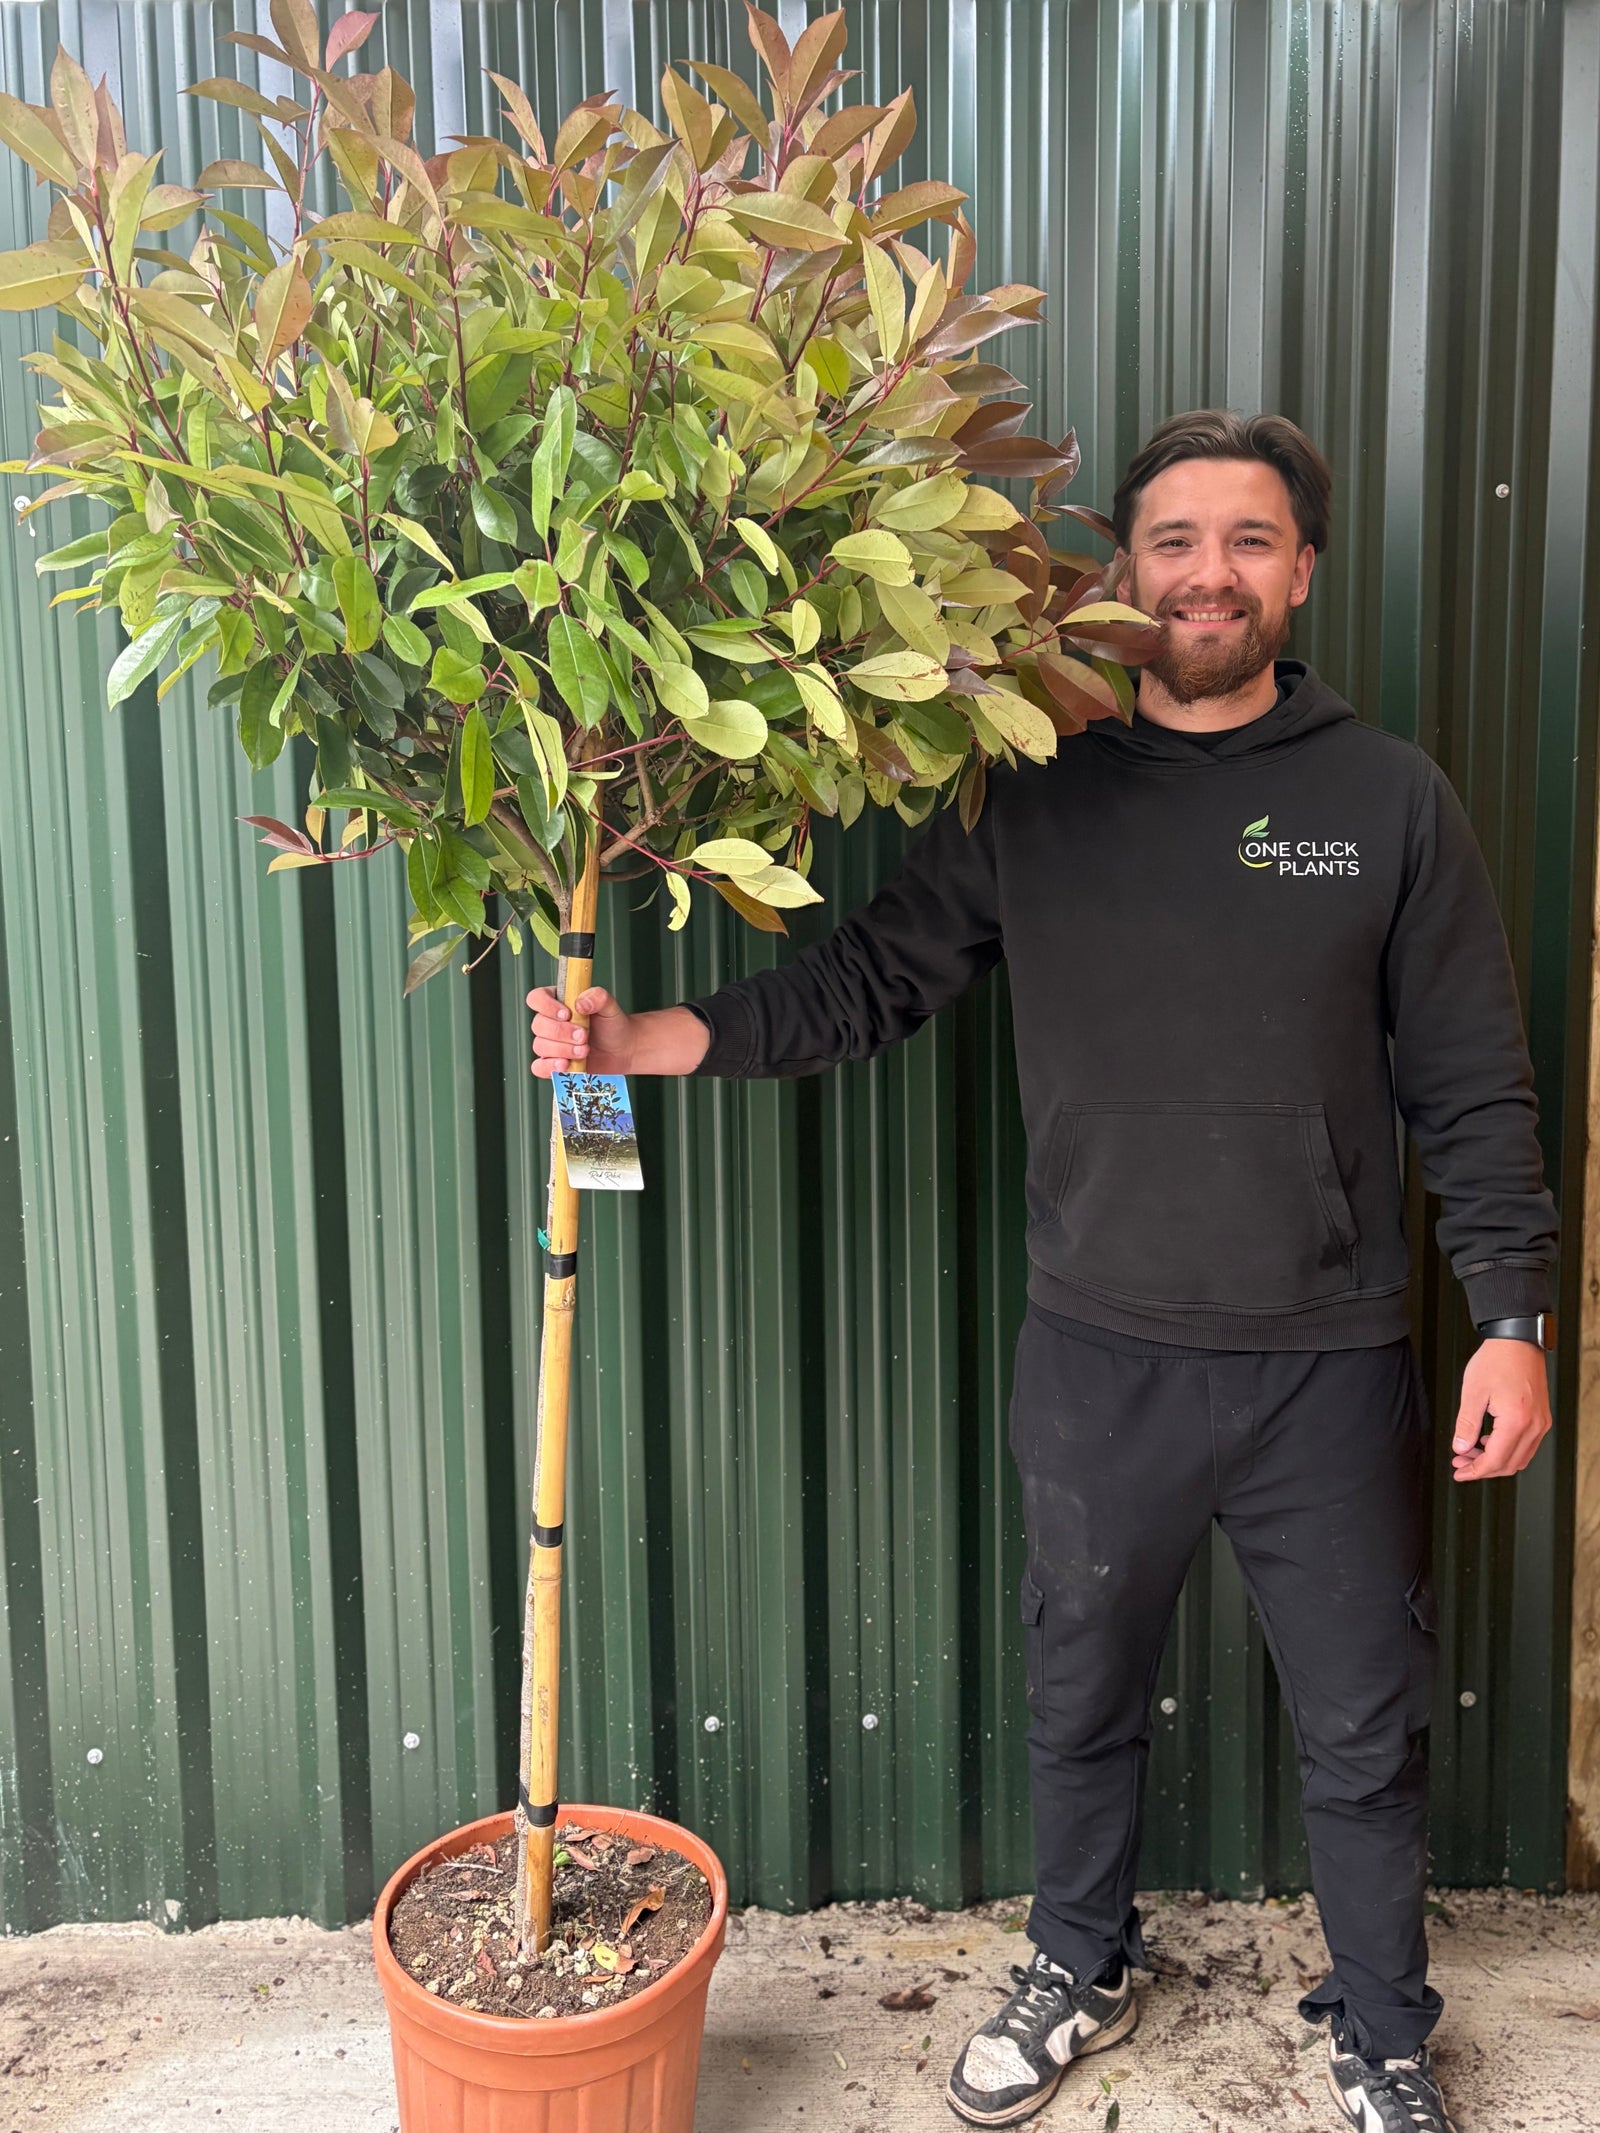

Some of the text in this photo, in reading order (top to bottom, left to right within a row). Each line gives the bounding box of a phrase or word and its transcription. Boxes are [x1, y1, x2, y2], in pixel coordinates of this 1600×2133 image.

[1245, 841, 1359, 857] ONE CLICK
[1279, 860, 1360, 876] PLANTS
